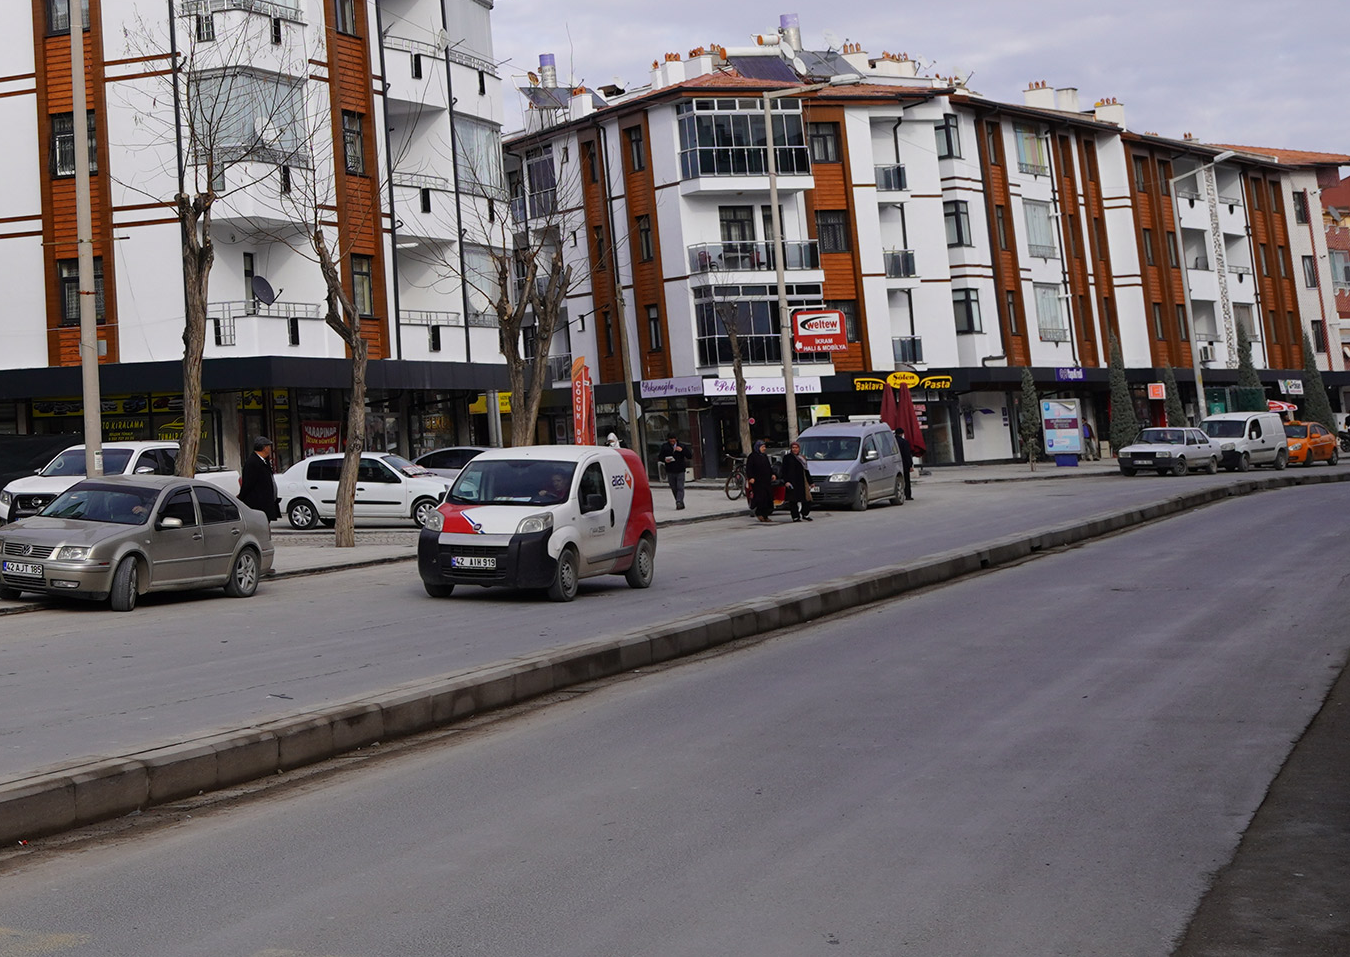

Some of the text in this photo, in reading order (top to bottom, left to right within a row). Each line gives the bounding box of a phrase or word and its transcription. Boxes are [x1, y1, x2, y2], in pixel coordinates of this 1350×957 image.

[806, 320, 838, 329] weltew
[856, 382, 883, 391] Baklava
[924, 380, 950, 389] Pasta
[612, 475, 625, 486] aras
